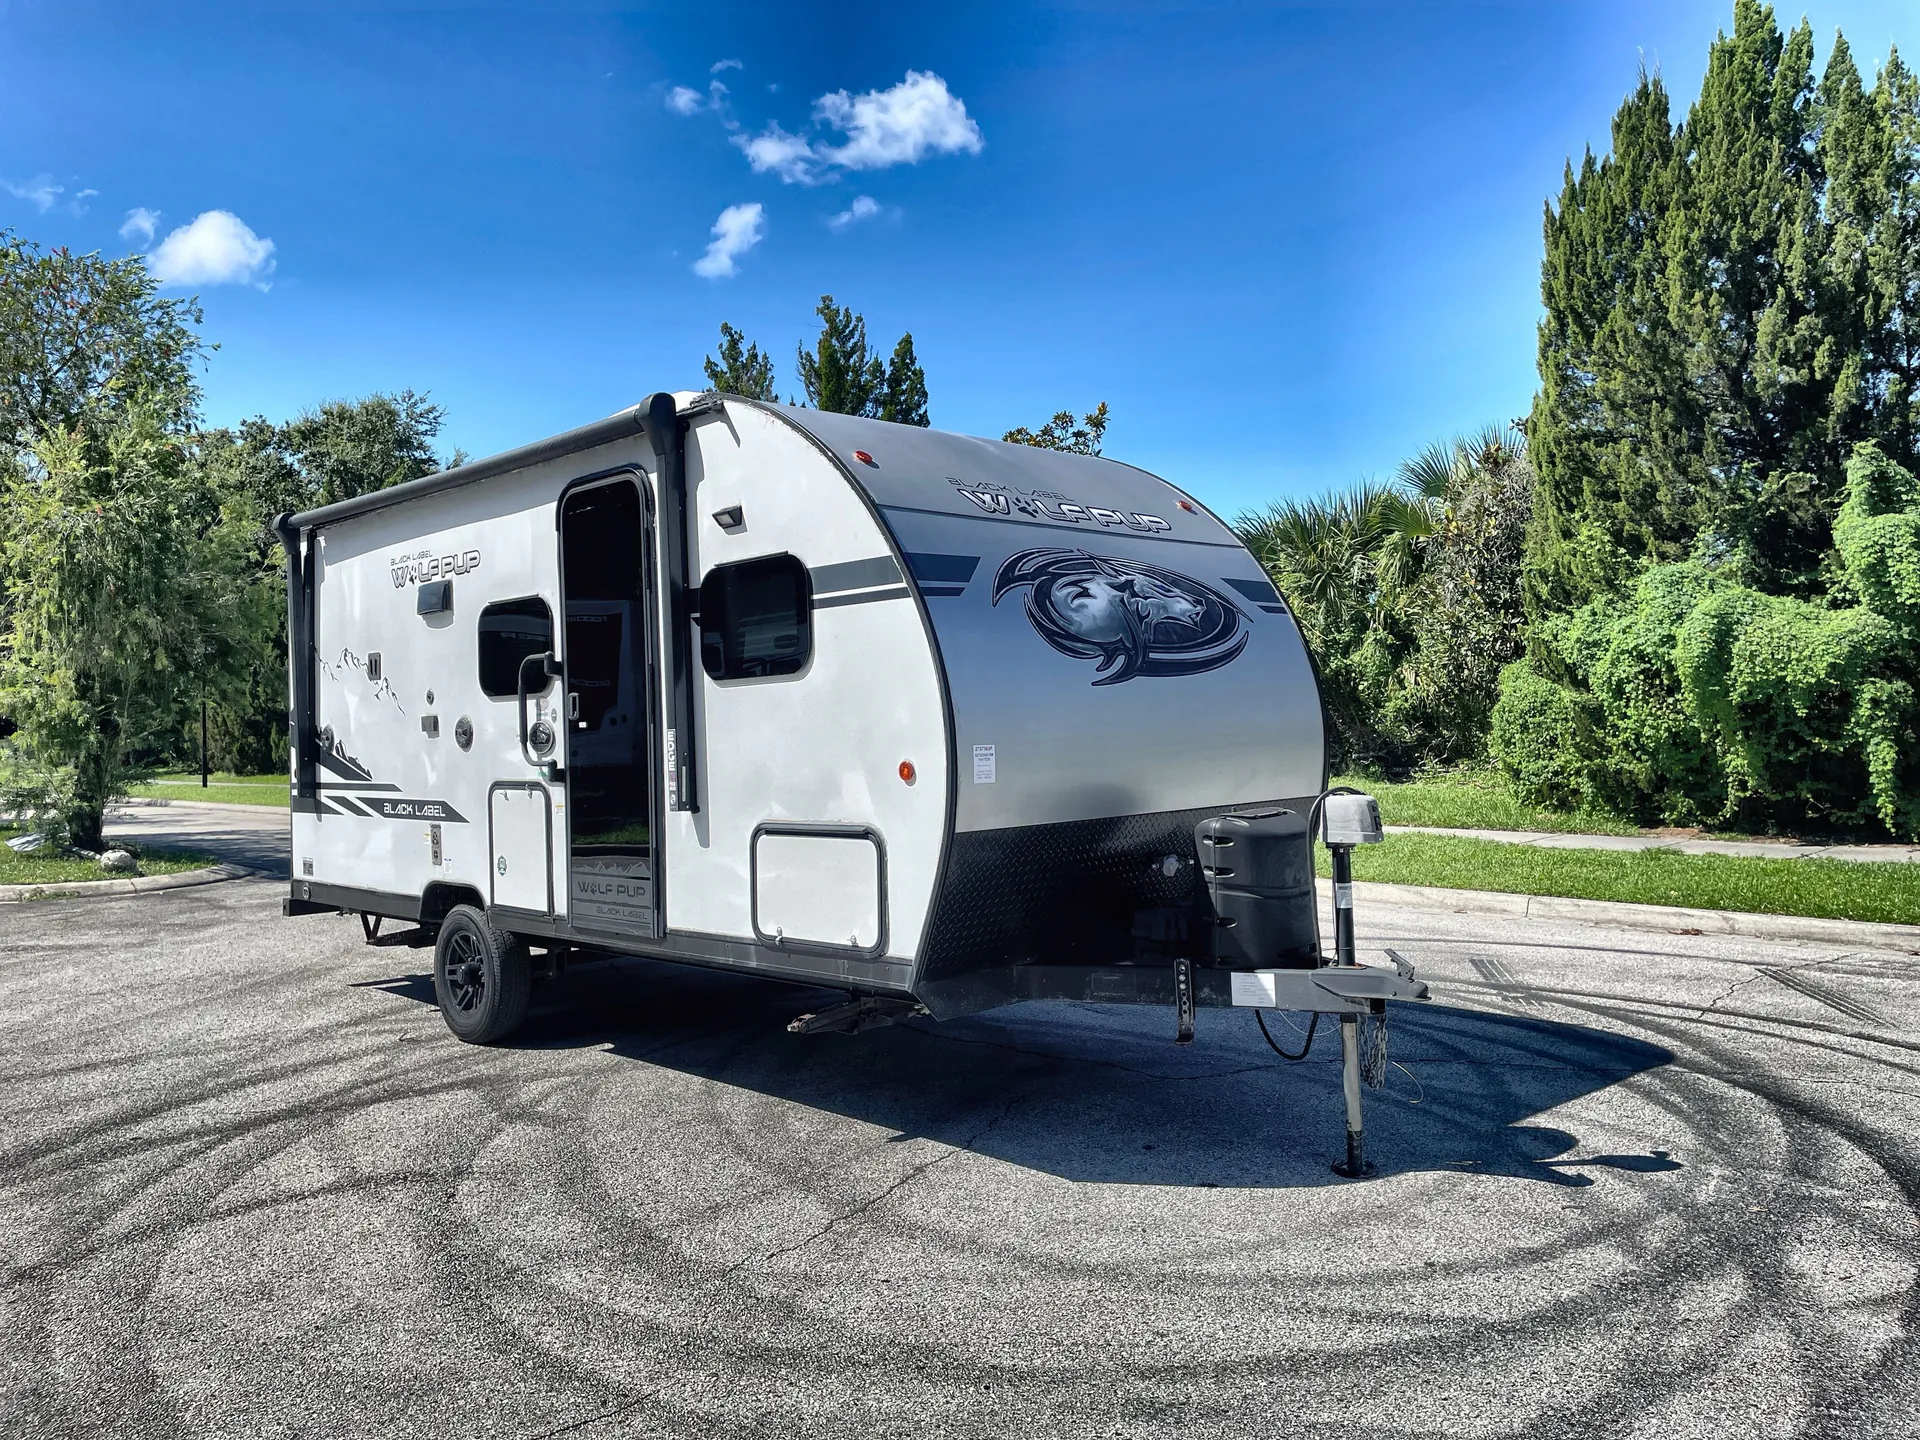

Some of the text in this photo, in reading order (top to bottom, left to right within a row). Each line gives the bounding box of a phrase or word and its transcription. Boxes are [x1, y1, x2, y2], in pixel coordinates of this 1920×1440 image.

[945, 476, 1075, 501] BLACK LABEL
[1086, 506, 1172, 533] PUP
[390, 550, 433, 566] BLACK LABEL
[441, 549, 481, 578] PUP
[667, 731, 676, 771] EDGE
[383, 803, 446, 817] BLACK LABEL
[616, 884, 646, 898] PUP
[596, 906, 648, 919] BLACK LABEL
